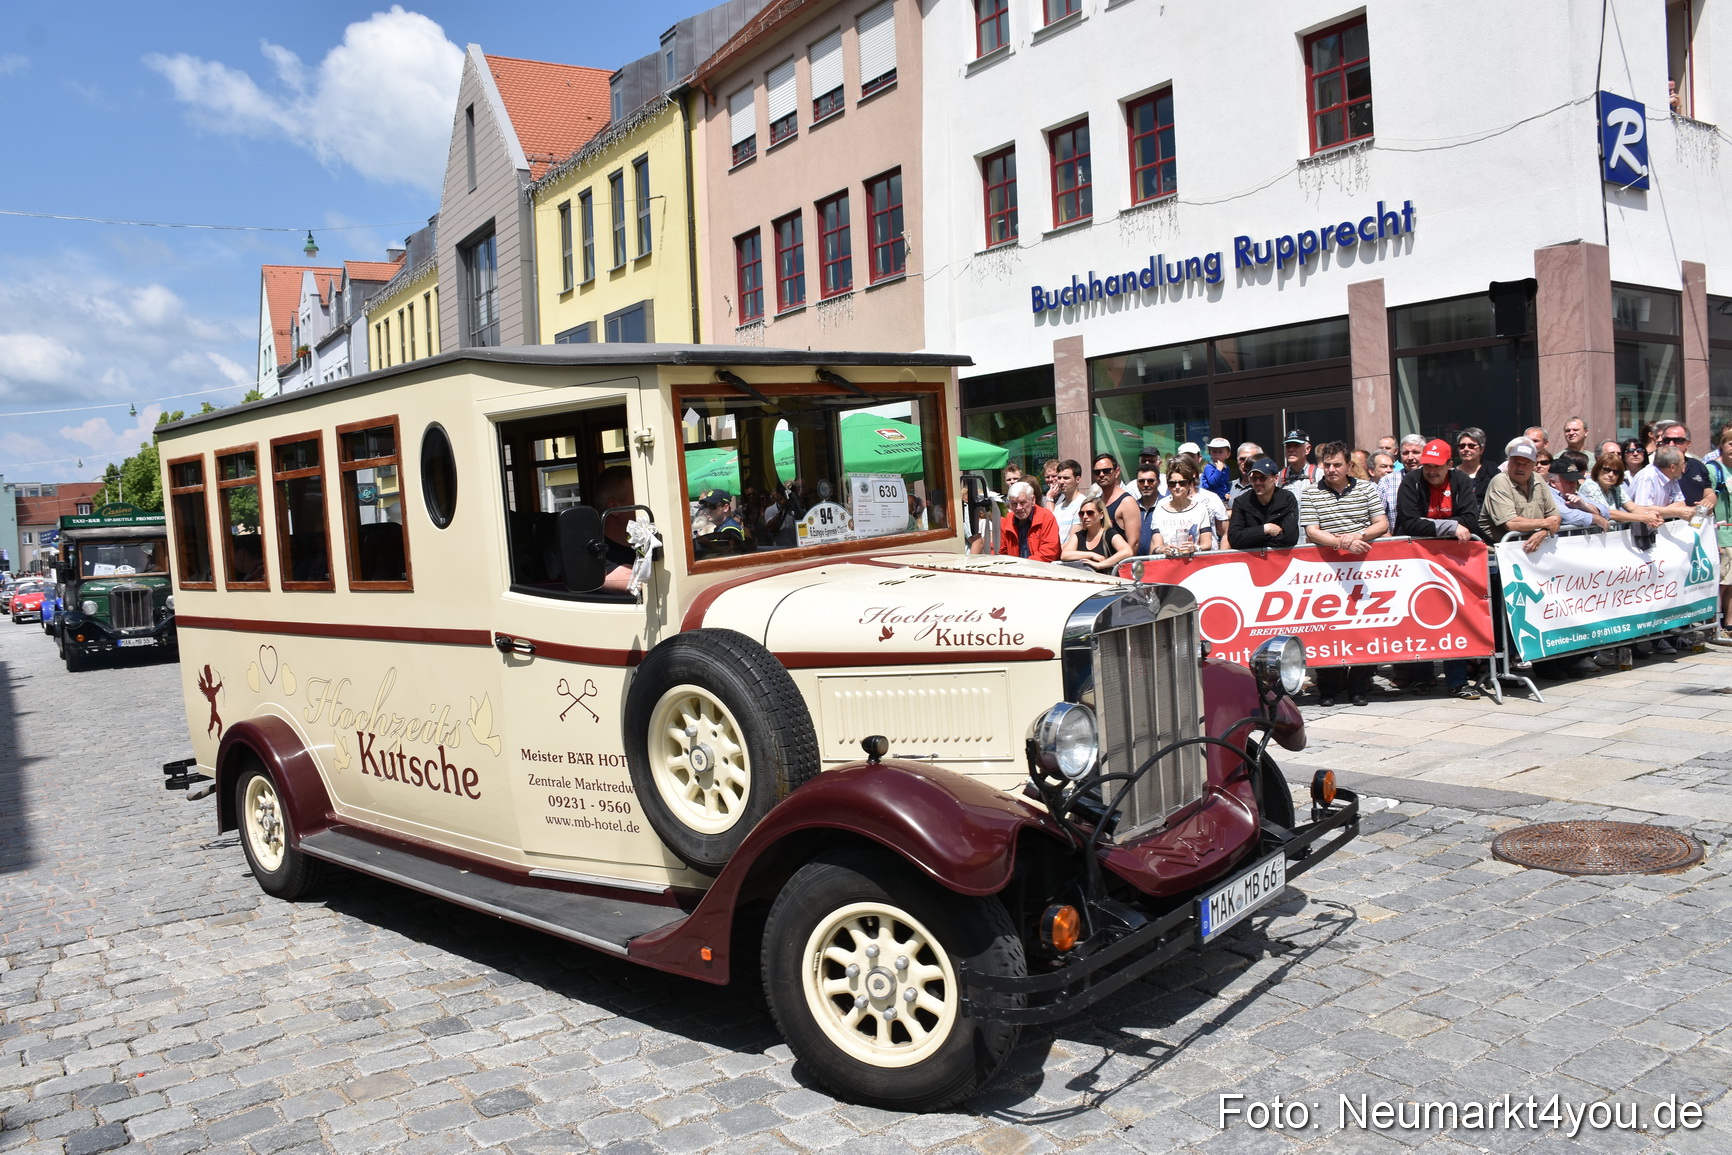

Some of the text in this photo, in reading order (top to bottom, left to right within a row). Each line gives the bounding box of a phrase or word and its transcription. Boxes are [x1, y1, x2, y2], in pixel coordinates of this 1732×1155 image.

[1031, 200, 1415, 313] Buchhandlung Rupprecht
[879, 485, 897, 498] 630
[820, 507, 833, 525] 94
[1288, 564, 1402, 585] Autoklassik
[1566, 570, 1605, 592] UNS
[1255, 584, 1396, 622] Dietz
[1612, 580, 1678, 608] BESSER
[859, 602, 983, 641] Hochzeits
[1249, 624, 1327, 636] BREITENBRUNN
[935, 627, 1025, 646] Kutsche
[1546, 632, 1590, 648] Service-Line:
[303, 666, 461, 782] Hochzeits
[356, 731, 482, 800] Kutsche
[521, 749, 627, 768] Meister BÄR HOT
[528, 774, 634, 794] Zentrale Marktredw
[548, 795, 586, 810] 09231
[599, 800, 631, 814] 9560
[545, 815, 640, 834] www.mb-hotel.de
[1211, 886, 1235, 927] MAK
[1244, 872, 1260, 905] MB
[1263, 861, 1277, 892] 66
